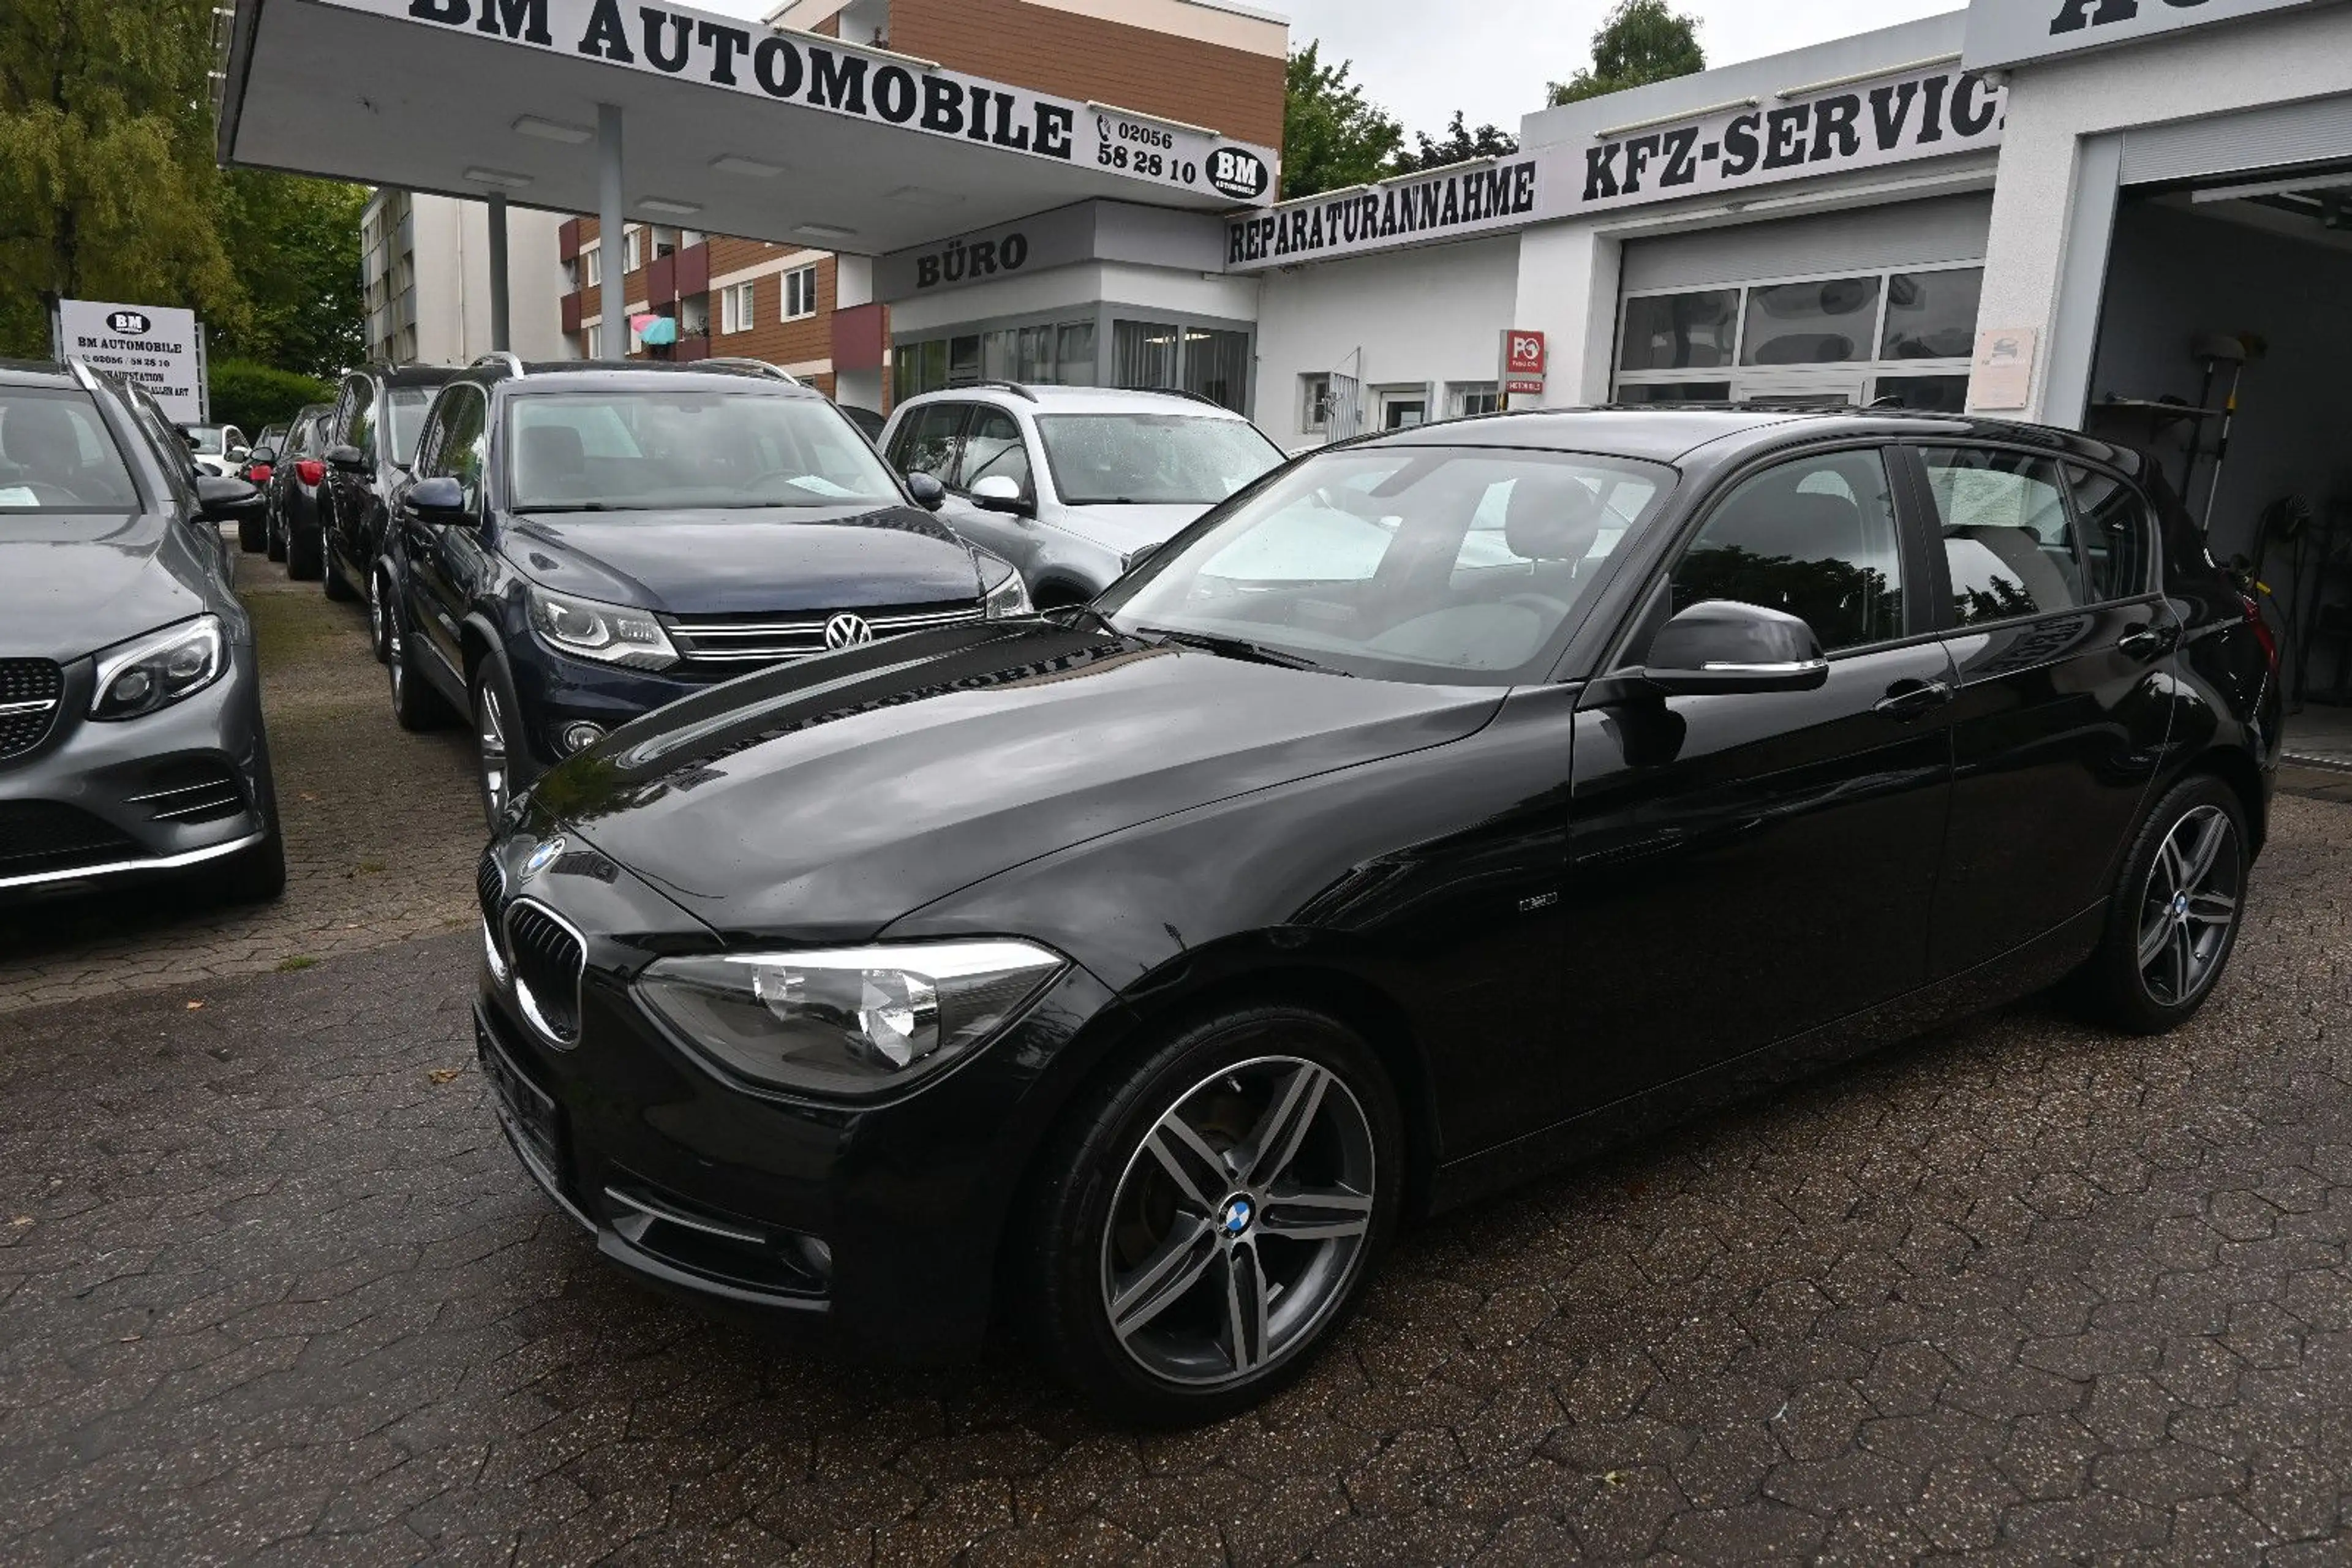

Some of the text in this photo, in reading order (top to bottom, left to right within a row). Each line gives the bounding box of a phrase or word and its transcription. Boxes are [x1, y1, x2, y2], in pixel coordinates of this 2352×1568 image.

[578, 0, 1074, 160] AUTOMOBILE
[1118, 123, 1172, 149] 02056
[1582, 68, 2005, 201] KFZ-SERVIC
[1098, 142, 1196, 184] 58 28 10
[1216, 151, 1257, 186] BM
[1229, 161, 1535, 263] REPARATURANNAHME
[917, 233, 1028, 289] BÜRO
[115, 314, 142, 328] BM
[78, 336, 182, 353] BM AUTOMOBILE
